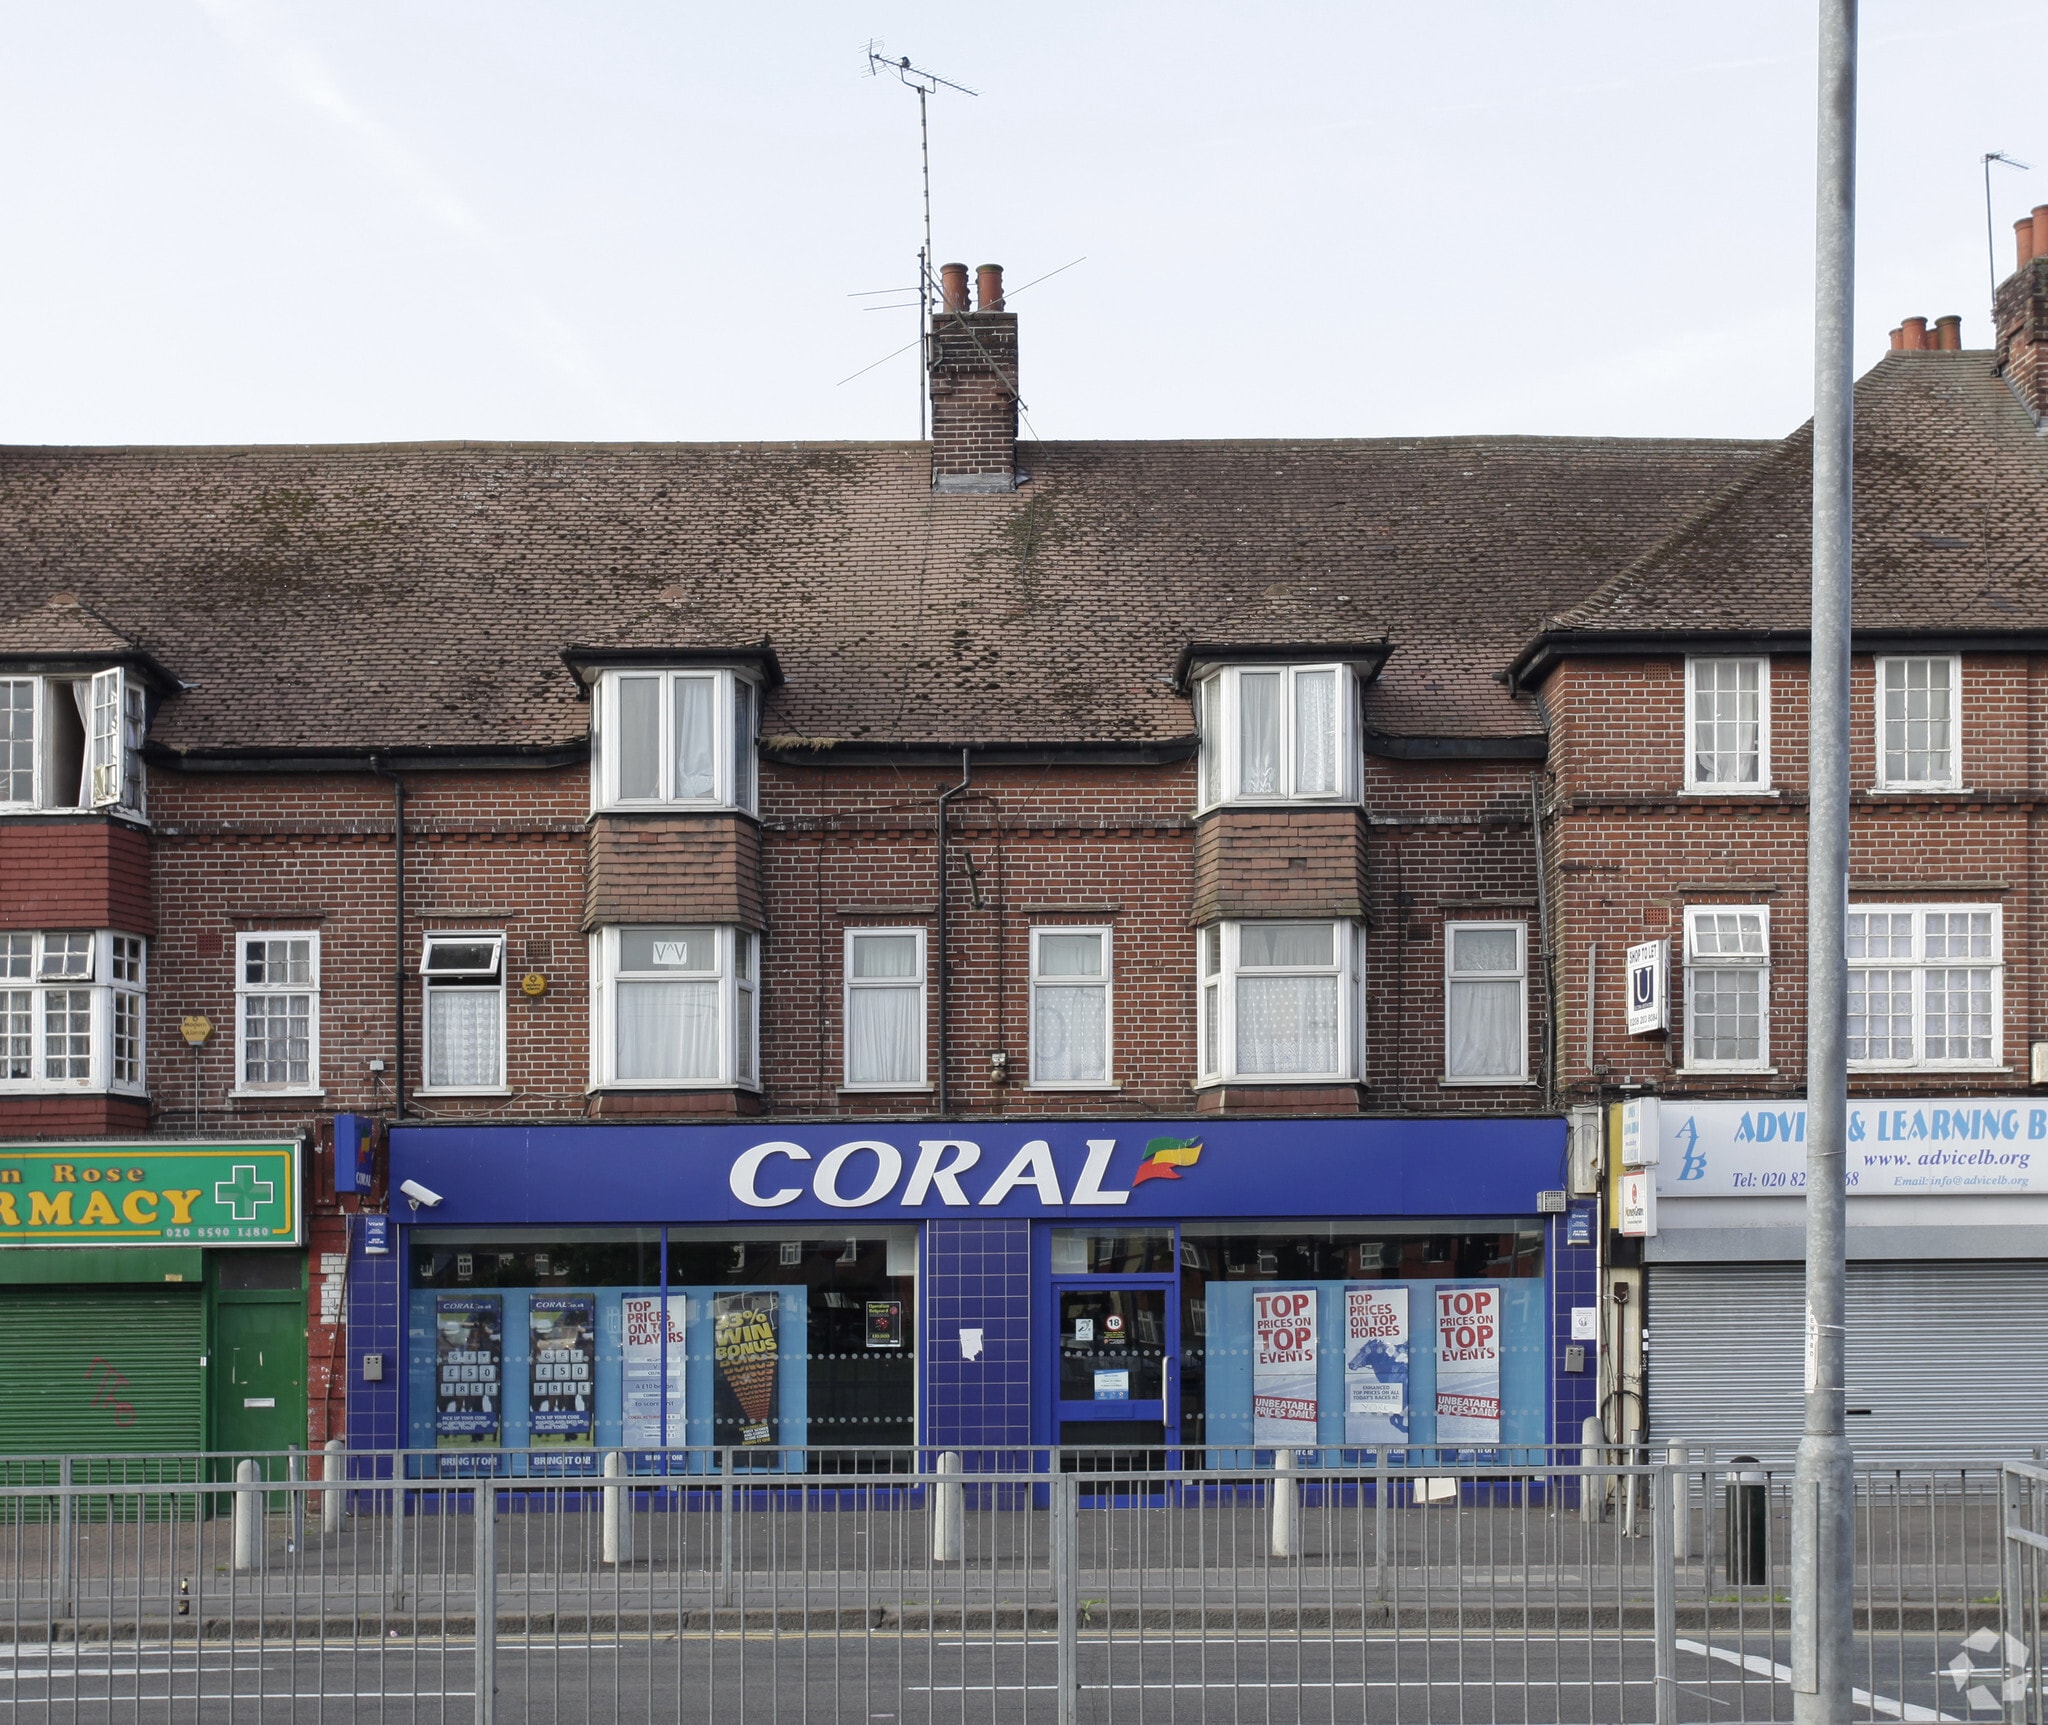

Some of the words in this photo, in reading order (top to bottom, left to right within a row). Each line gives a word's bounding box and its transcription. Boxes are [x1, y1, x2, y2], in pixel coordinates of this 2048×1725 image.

[1629, 949, 1641, 964] SHOP
[1642, 946, 1648, 960] TO
[1649, 943, 1657, 958] LET
[1734, 1110, 1806, 1143] ADVI
[1848, 1110, 1866, 1142] &
[1877, 1108, 2020, 1141] LEARNING
[1864, 1153, 1911, 1167] www.
[1917, 1149, 2031, 1169] advicelb.org
[53, 1163, 146, 1184] Rose
[356, 1171, 372, 1187] CORAL
[729, 1139, 1130, 1207] CORAL
[1732, 1172, 1757, 1187] Tel:
[1761, 1172, 1786, 1187] 020
[1893, 1176, 1929, 1187] Email:
[1931, 1175, 2029, 1188] info@advicelb.org
[166, 1227, 190, 1238] 020
[197, 1227, 230, 1238] 8590
[237, 1226, 270, 1237] 1480
[1256, 1294, 1309, 1318] TOP
[1349, 1294, 1372, 1305] TOP
[1439, 1292, 1491, 1316] TOP
[626, 1301, 651, 1313] TOP
[1349, 1304, 1392, 1316] PRICES
[715, 1308, 767, 1330] 33%
[1108, 1319, 1120, 1327] 18
[1257, 1319, 1293, 1329] PRICES
[1294, 1317, 1311, 1327] ON
[1350, 1316, 1369, 1327] ON
[1372, 1314, 1397, 1326] TOP
[1440, 1316, 1475, 1327] PRICES
[1477, 1315, 1494, 1325] ON
[628, 1323, 647, 1335] ON
[715, 1322, 773, 1346] WIN
[1351, 1325, 1400, 1338] HORSES
[629, 1332, 684, 1346] PLAYRS
[1258, 1327, 1311, 1351] TOP
[1440, 1325, 1494, 1349] TOP
[715, 1337, 778, 1358] BONUS
[1442, 1347, 1495, 1362] EVENTS
[1260, 1349, 1313, 1364] EVENTS
[541, 1366, 583, 1376] £50
[445, 1385, 494, 1393] FREE
[538, 1384, 587, 1392] FREE
[1255, 1398, 1315, 1412] UNBEATABLE
[1438, 1396, 1498, 1409] UNBEATABLE
[1254, 1406, 1286, 1417] PRICES
[1287, 1409, 1316, 1420] DAILY
[1437, 1404, 1468, 1415] PRICES
[1470, 1407, 1499, 1418] DAILY
[534, 1456, 563, 1465] BRING
[565, 1456, 573, 1465] IT
